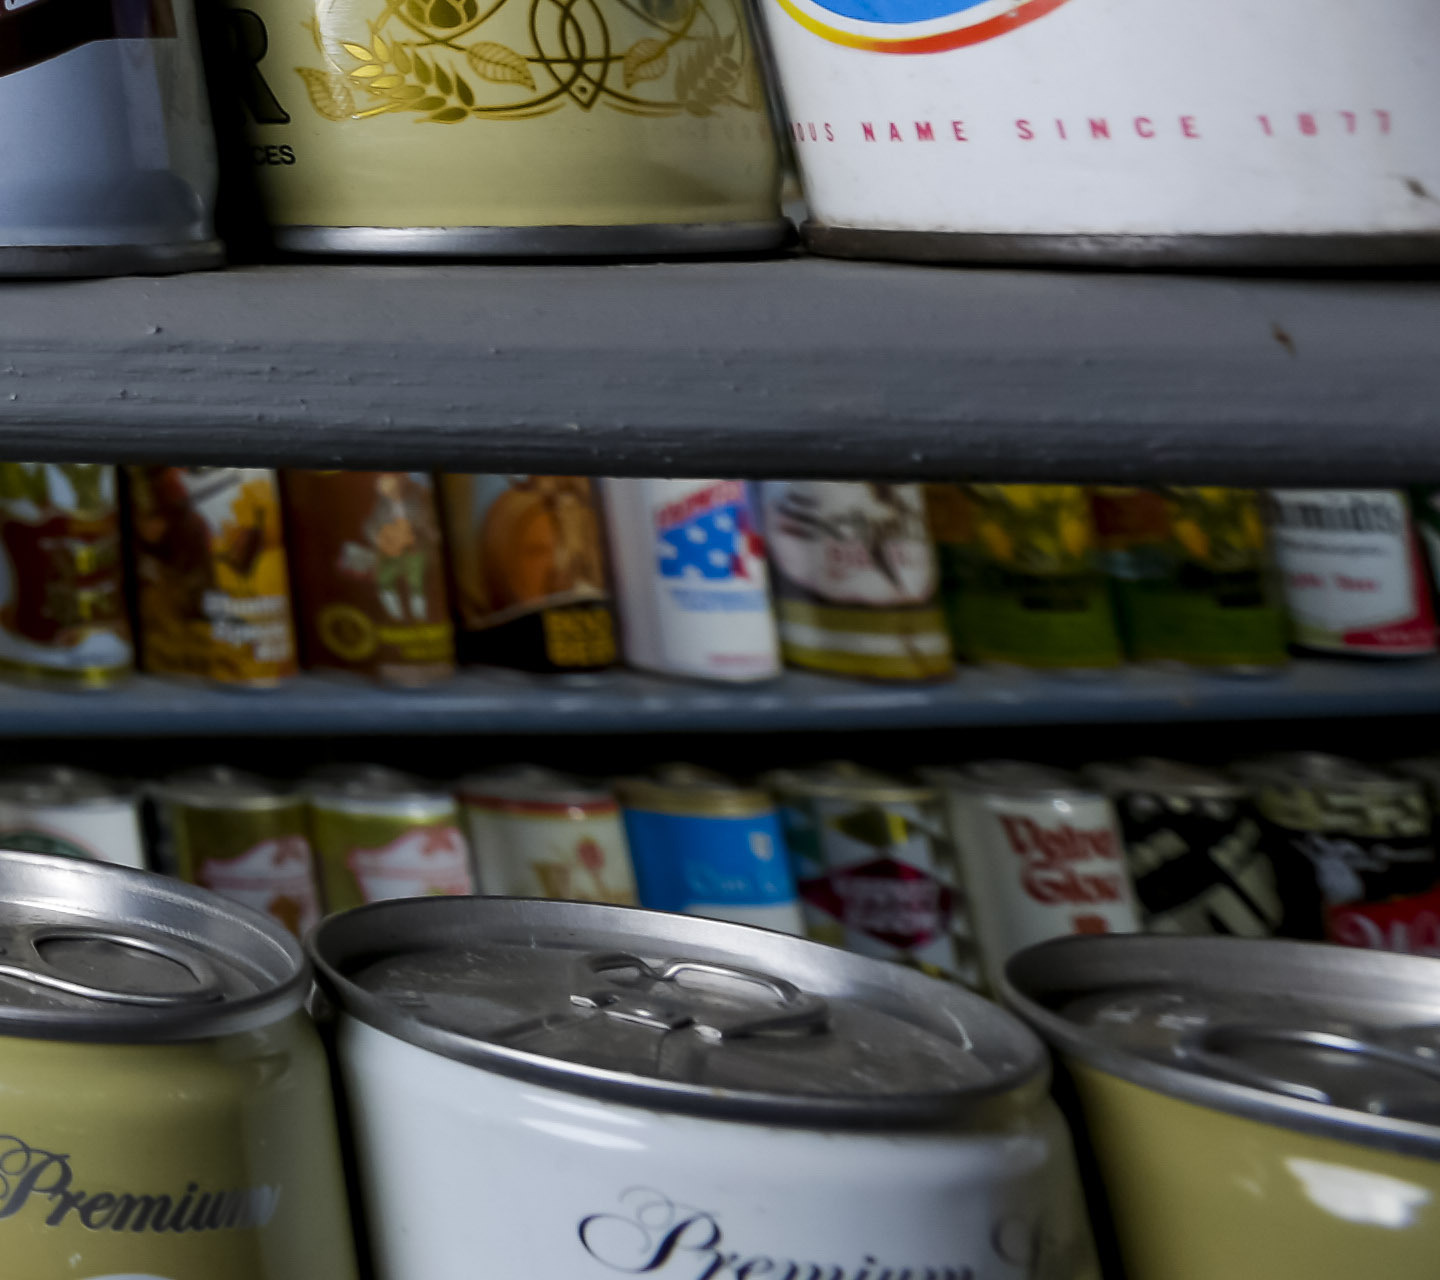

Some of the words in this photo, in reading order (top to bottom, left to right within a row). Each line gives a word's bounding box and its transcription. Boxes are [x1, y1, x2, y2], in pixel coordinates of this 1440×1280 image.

[862, 119, 970, 143] NAME
[1017, 115, 1203, 143] SINCE
[1256, 108, 1394, 138] 1877
[576, 1182, 976, 1280] Premium
